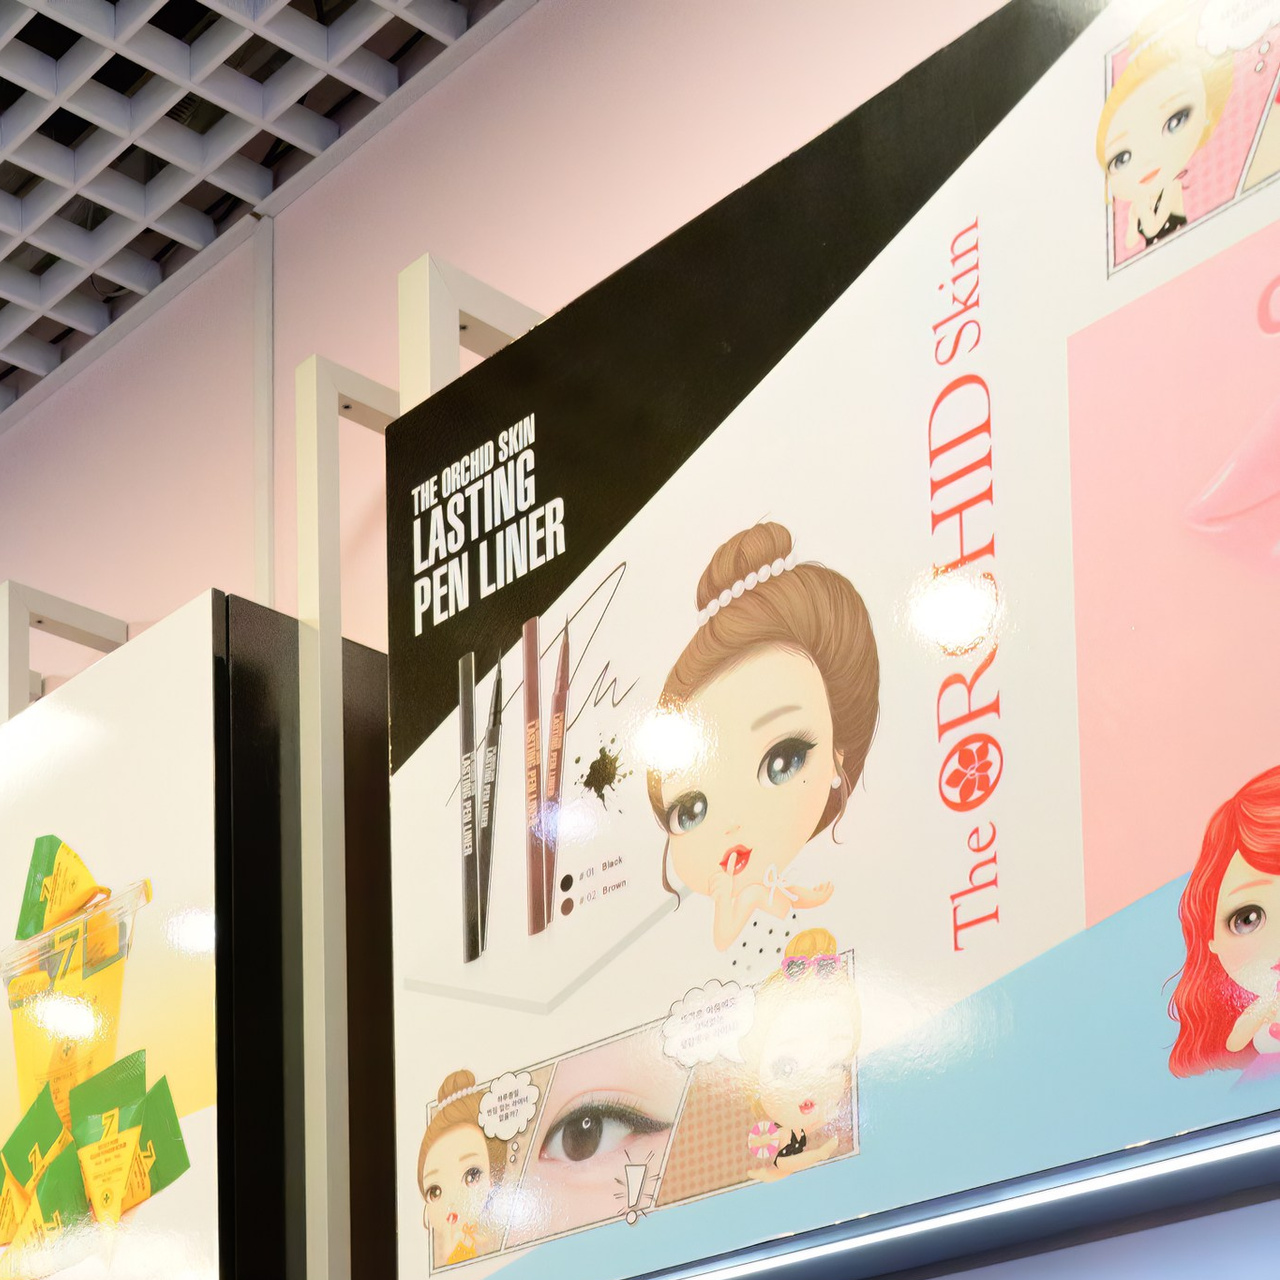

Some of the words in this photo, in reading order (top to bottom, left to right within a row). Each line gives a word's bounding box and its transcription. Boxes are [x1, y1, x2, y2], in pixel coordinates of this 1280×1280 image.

[931, 213, 982, 366] Skin
[411, 475, 438, 516] THE
[441, 440, 495, 498] ORCHID
[498, 412, 535, 460] SKIN
[413, 449, 536, 576] LASTING
[414, 552, 469, 637] PEN
[479, 497, 566, 599] LINER
[928, 374, 1004, 812] ORHID
[601, 855, 623, 872] Black
[602, 879, 627, 895] Brown
[949, 820, 1000, 951] The
